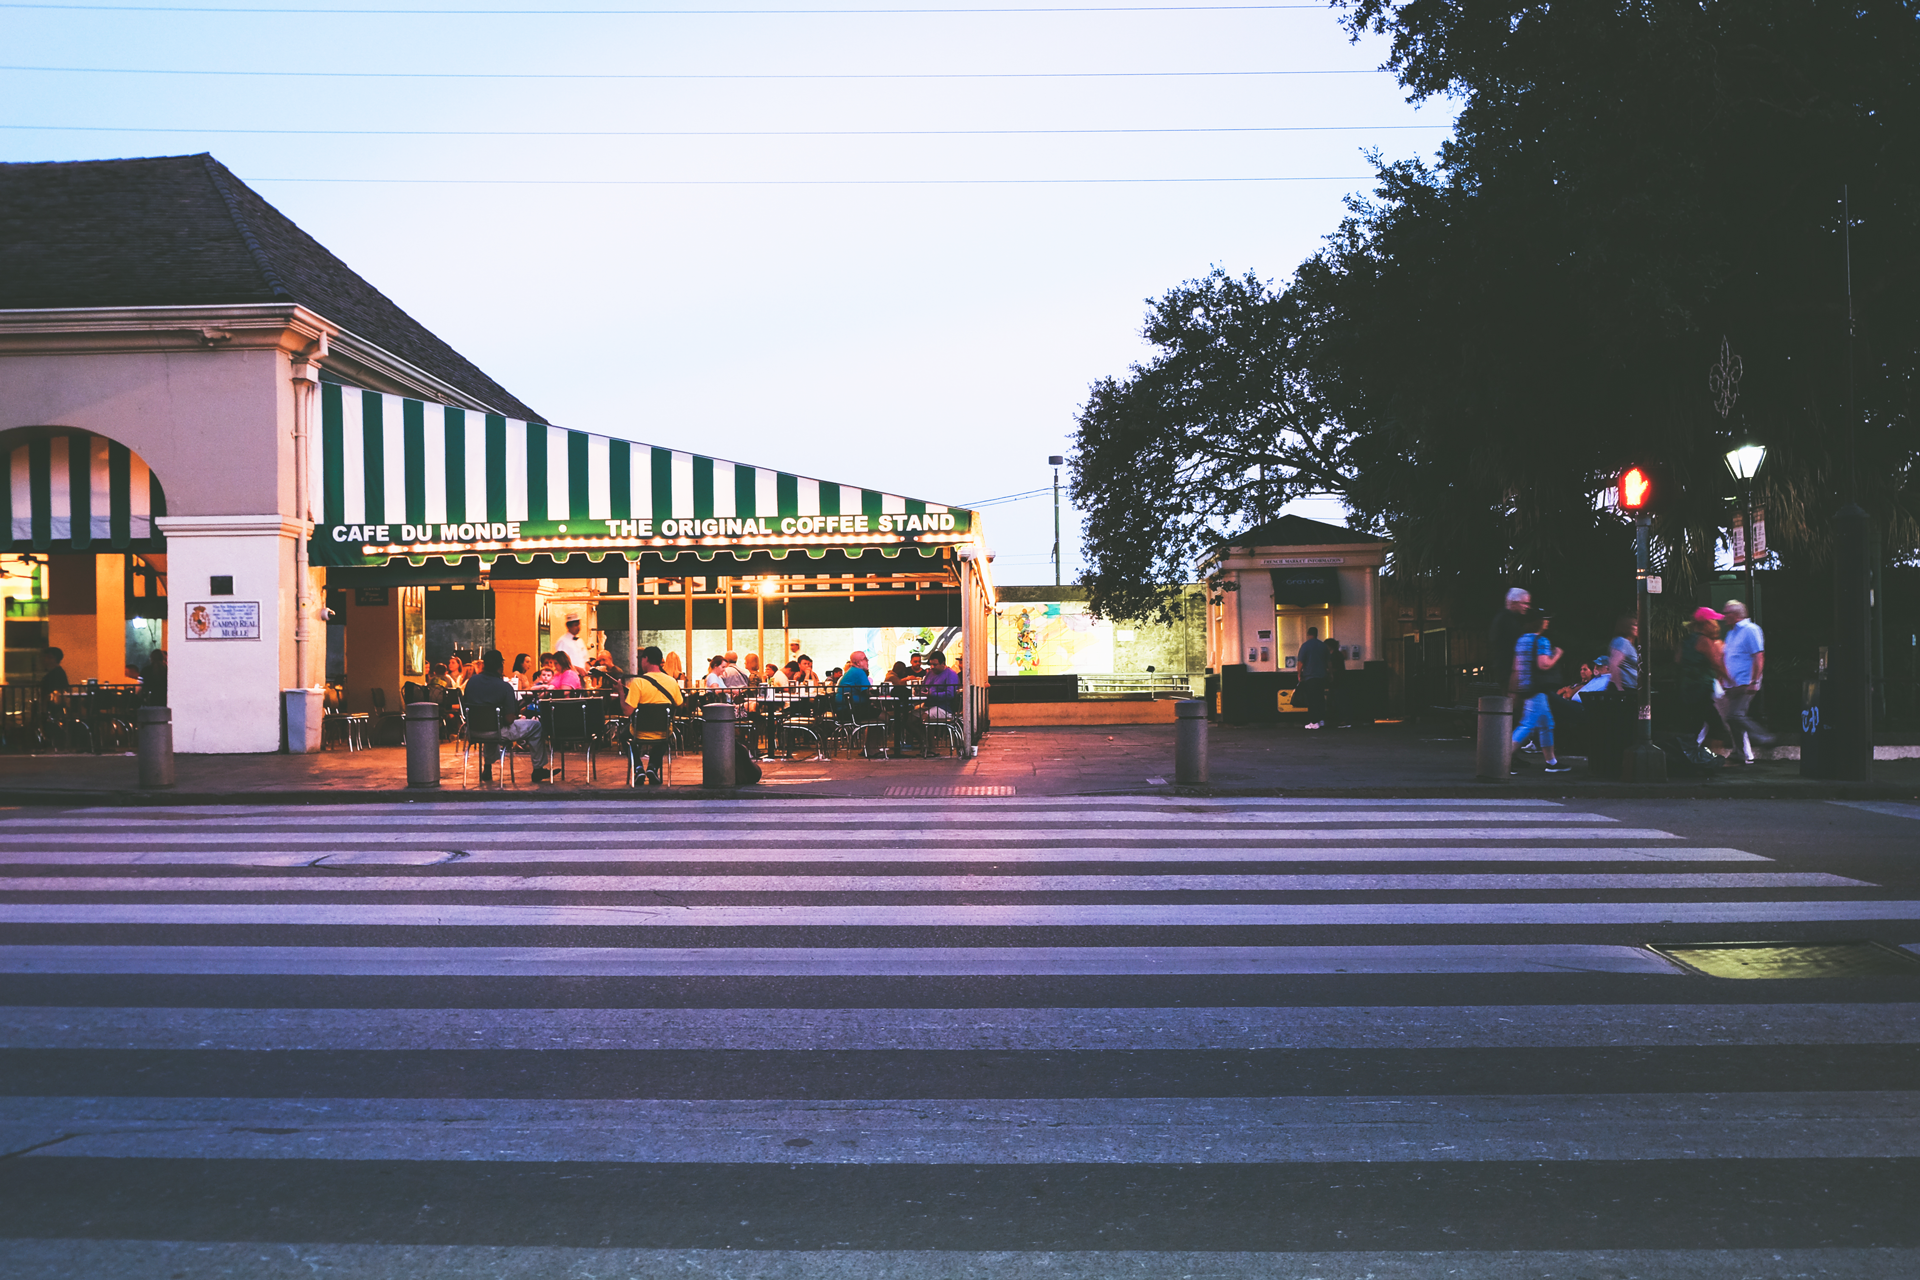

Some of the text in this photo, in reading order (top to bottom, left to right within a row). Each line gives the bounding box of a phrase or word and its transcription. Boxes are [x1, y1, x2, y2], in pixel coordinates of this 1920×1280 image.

[333, 523, 521, 542] CAFE DU MONDE
[605, 514, 955, 537] THE ORIGINAL COFFEE STAND
[212, 620, 239, 628] CAMINO
[239, 620, 258, 628] REAL
